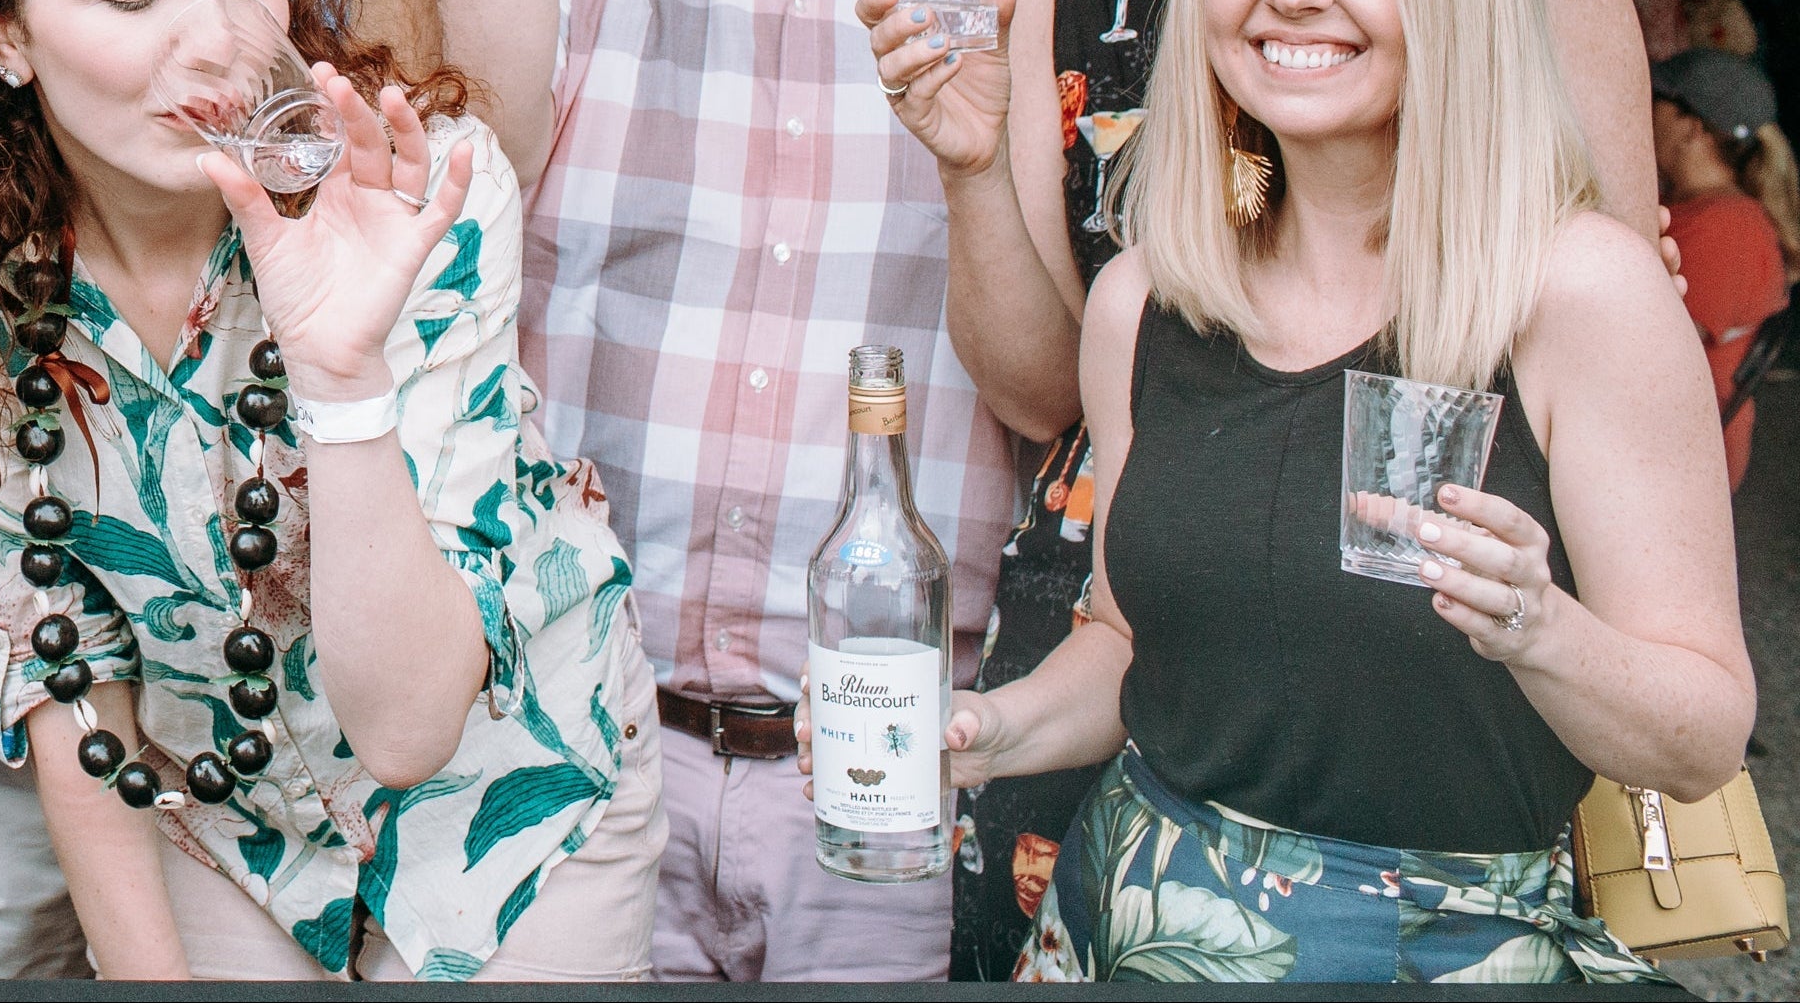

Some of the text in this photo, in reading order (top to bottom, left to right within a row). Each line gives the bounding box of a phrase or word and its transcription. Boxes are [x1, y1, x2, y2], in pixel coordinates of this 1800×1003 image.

[850, 547, 881, 559] 1862
[840, 673, 889, 695] Rhum
[822, 682, 916, 708] Barbancourt
[820, 725, 856, 743] WHITE
[849, 792, 887, 804] HAITI
